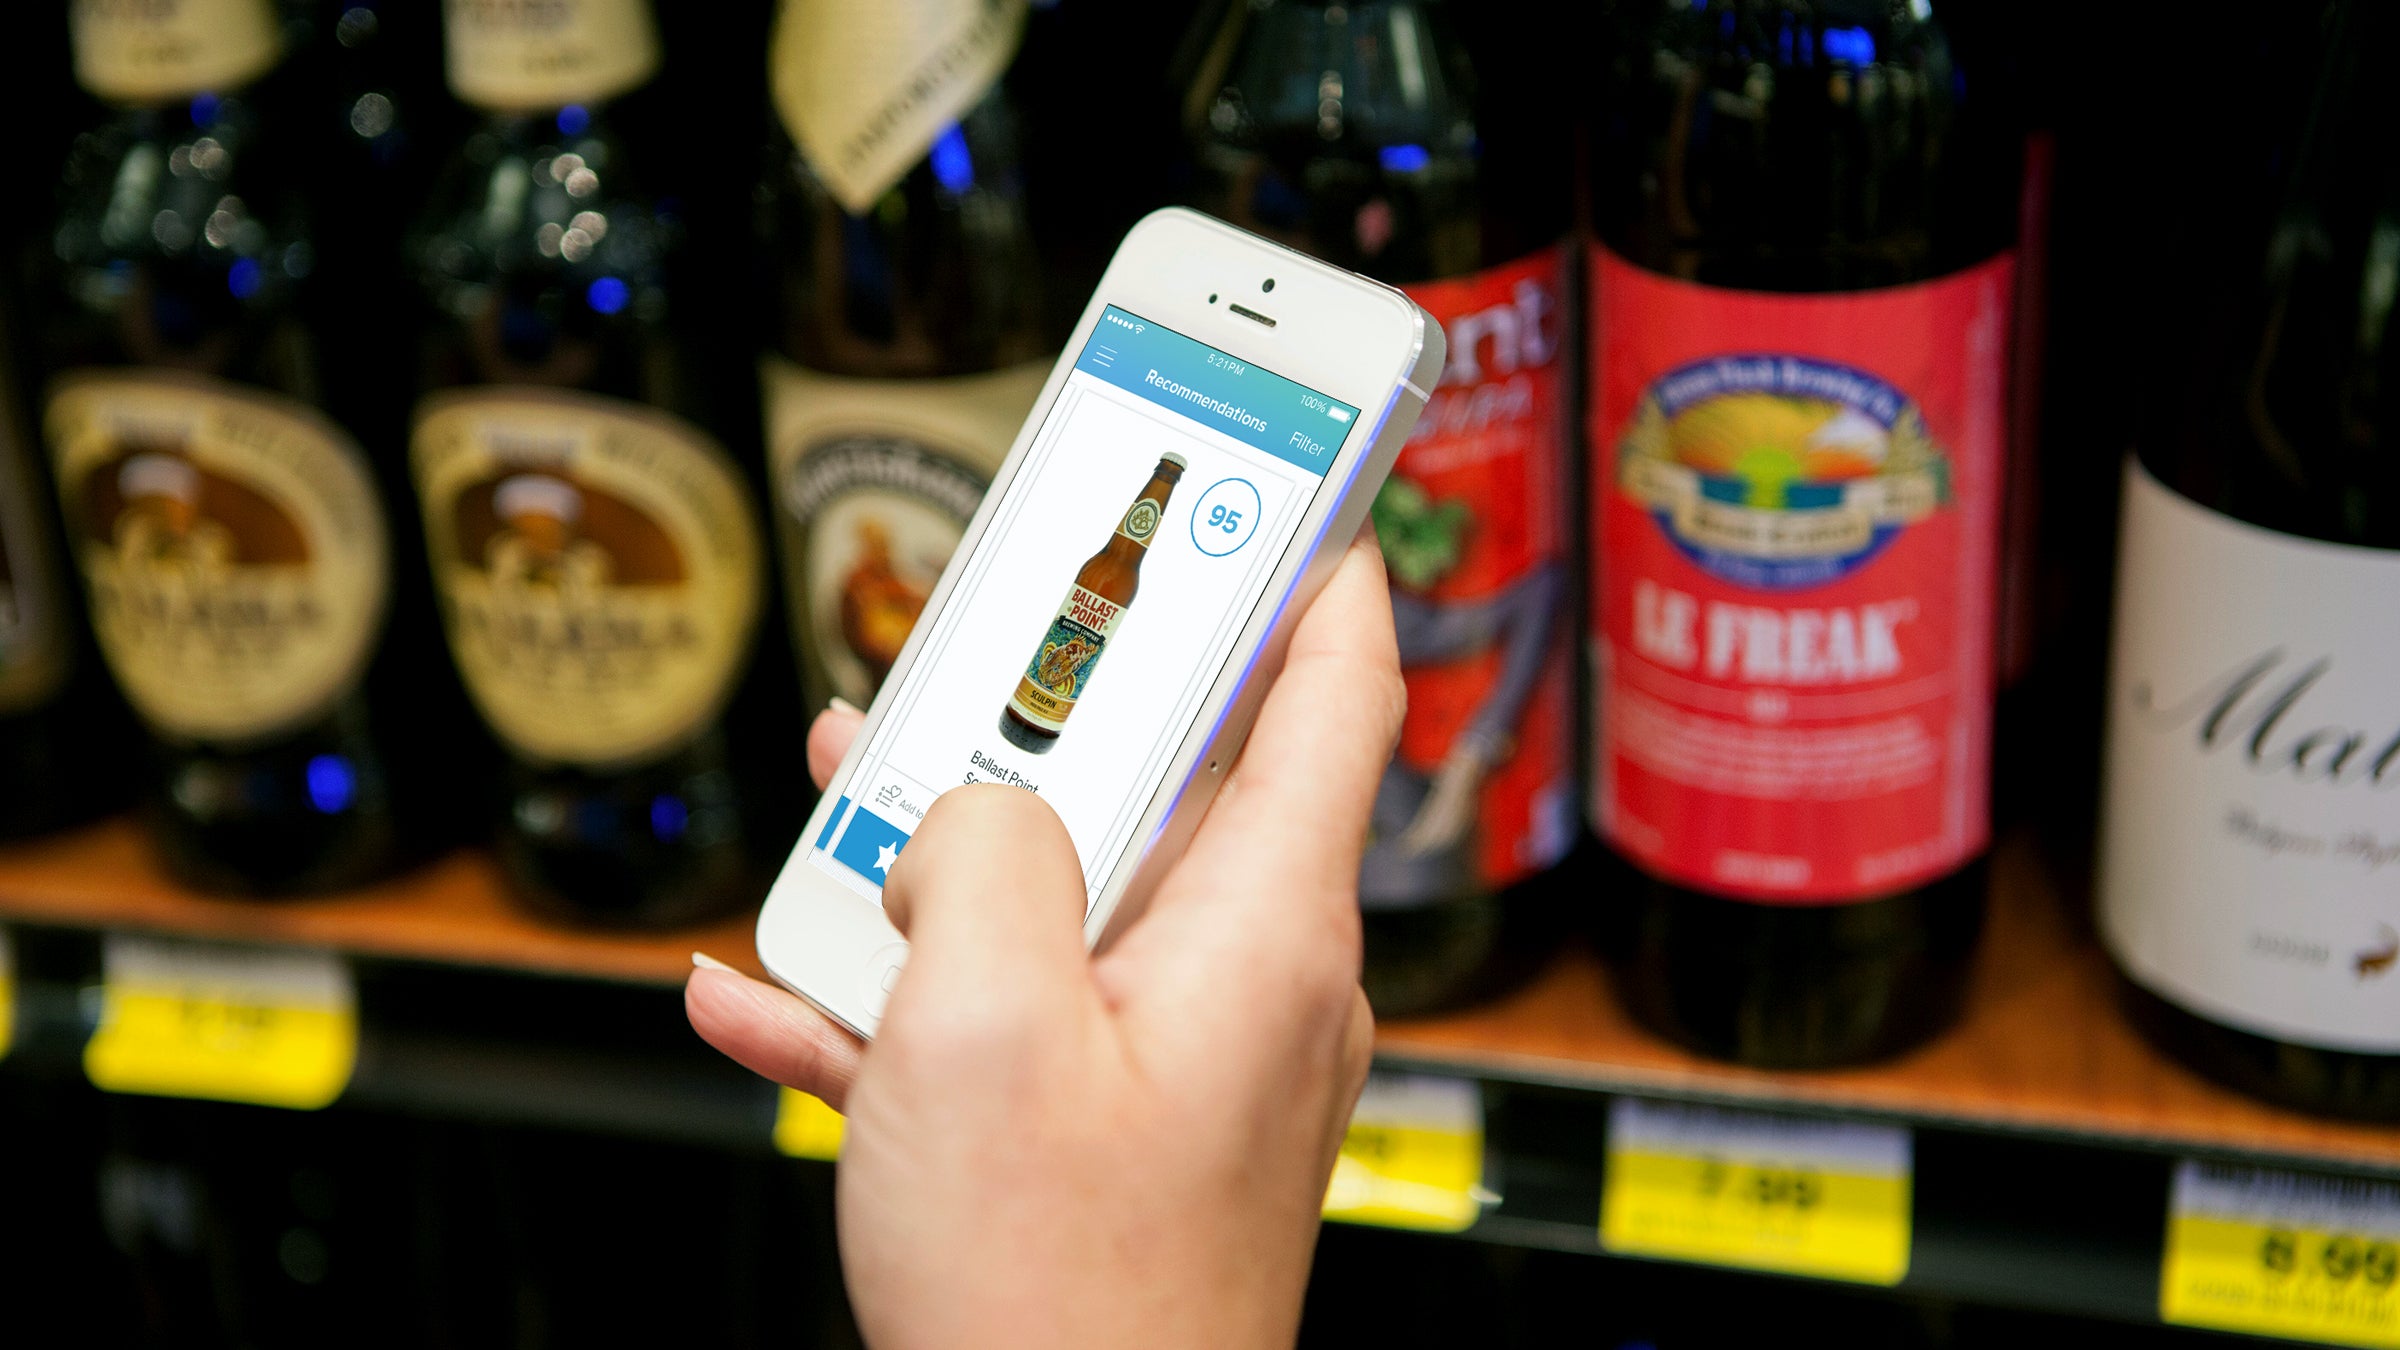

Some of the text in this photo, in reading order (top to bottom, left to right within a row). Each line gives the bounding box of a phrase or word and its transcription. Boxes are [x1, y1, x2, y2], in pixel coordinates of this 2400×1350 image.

[1207, 353, 1246, 377] 5:21PM
[1144, 368, 1268, 433] Recommendations
[1300, 394, 1328, 414] 100%
[1289, 431, 1326, 457] Filter
[1207, 504, 1243, 534] 95
[1069, 604, 1107, 631] POINT
[1071, 588, 1119, 620] BALLAST
[1633, 577, 1902, 685] LE FREAK
[1030, 689, 1058, 709] SCULPIN
[970, 750, 1009, 781] Ballast
[898, 799, 916, 815] Add
